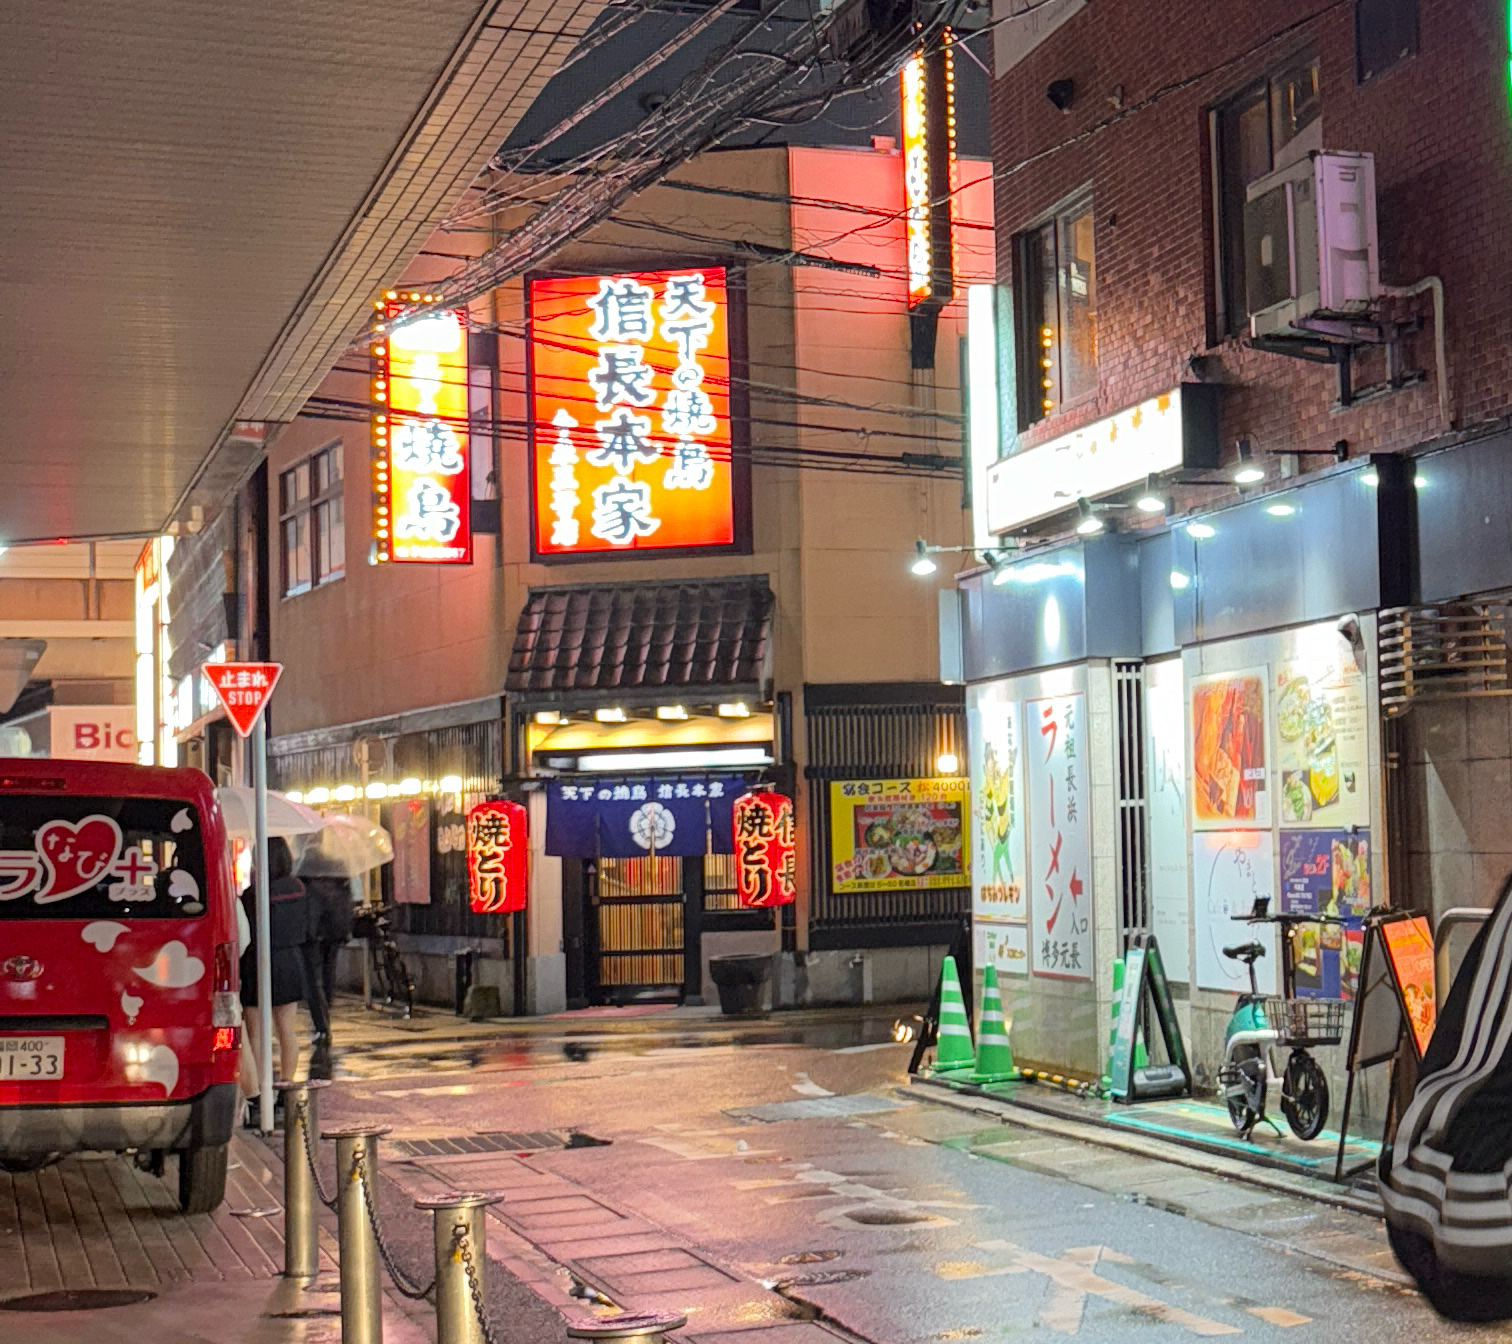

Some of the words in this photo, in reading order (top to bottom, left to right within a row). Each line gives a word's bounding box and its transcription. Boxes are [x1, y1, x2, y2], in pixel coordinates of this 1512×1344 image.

[586, 278, 662, 544] 信長本家
[219, 670, 269, 688] 止まれ
[228, 691, 262, 706] STOP
[75, 723, 133, 749] Bic
[933, 780, 970, 792] 4000
[1041, 706, 1063, 934] ラーメン
[472, 810, 513, 912] 焼とり
[736, 800, 775, 906] 焼とり
[1071, 911, 1088, 934] 入口
[20, 1040, 43, 1051] 400
[0, 1054, 57, 1076] 1-33
